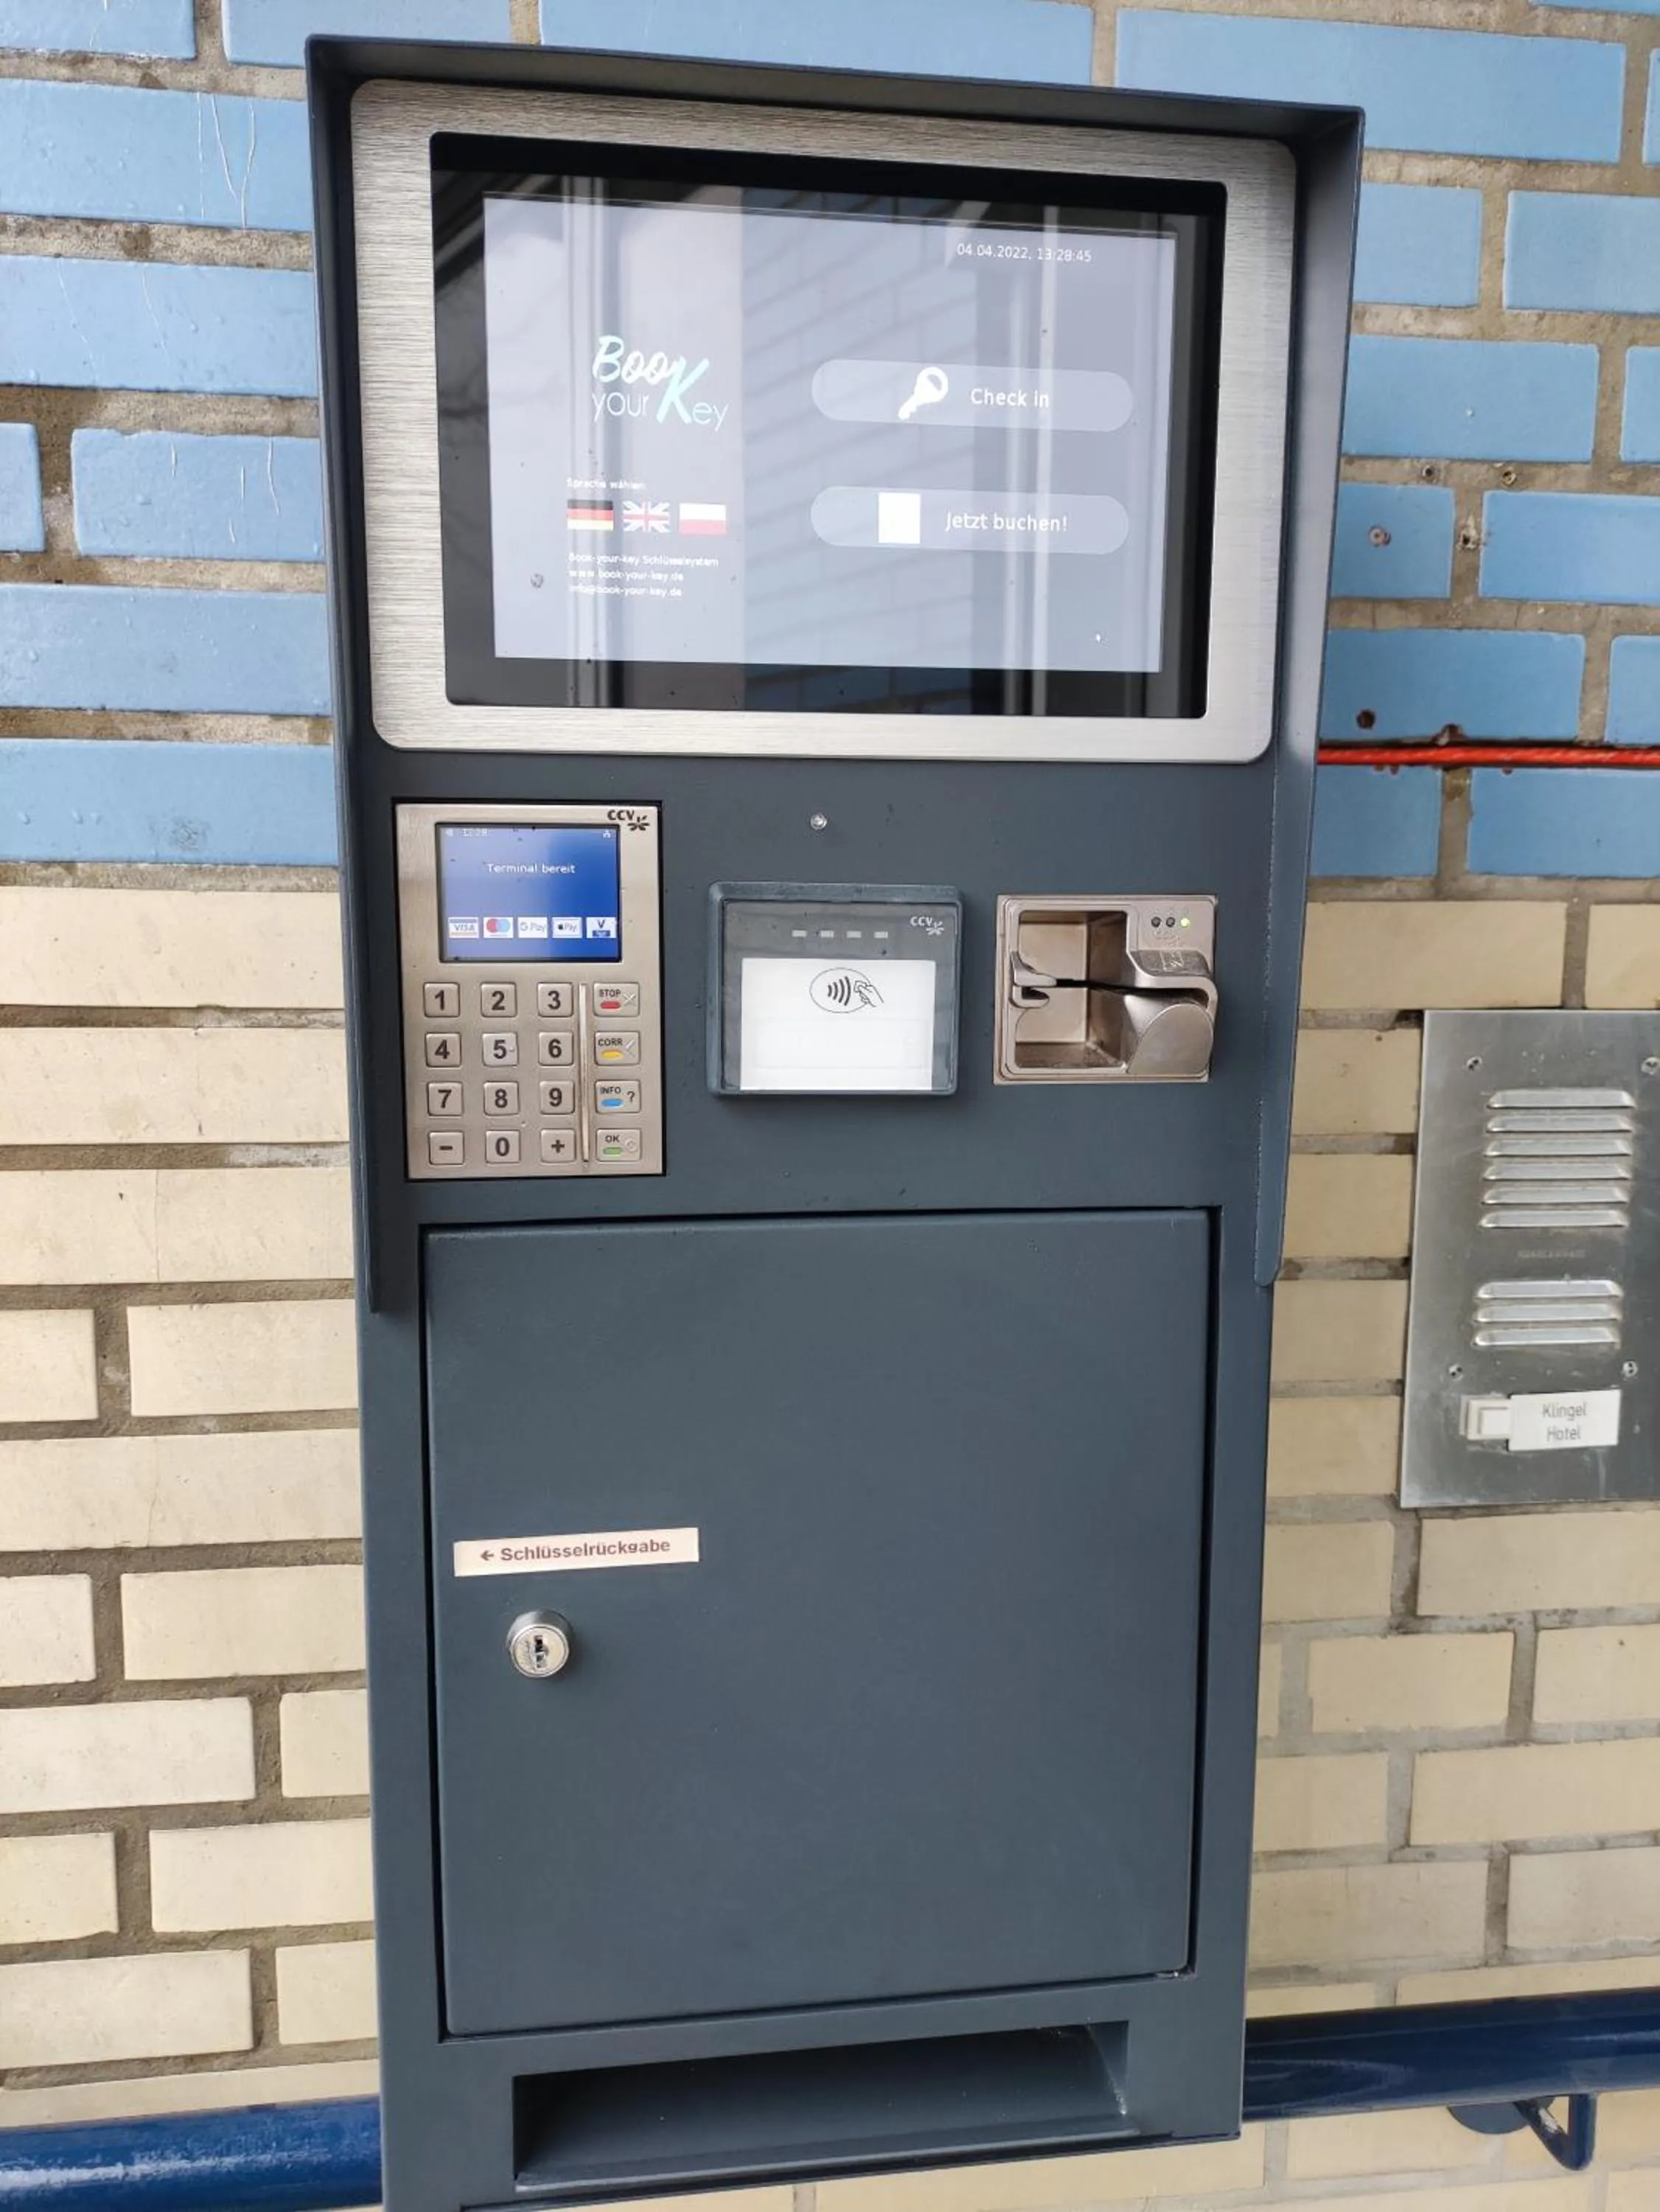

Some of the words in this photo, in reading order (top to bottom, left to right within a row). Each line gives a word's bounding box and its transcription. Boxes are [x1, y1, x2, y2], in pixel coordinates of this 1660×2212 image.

[958, 243, 1031, 260] 04.04.2022,
[1037, 247, 1092, 262] 13:28:45
[592, 392, 649, 423] your
[656, 356, 729, 432] Key
[970, 388, 1027, 408] Check
[1034, 389, 1050, 408] in
[944, 512, 988, 532] Jetzt
[993, 512, 1067, 532] buchen!
[607, 809, 635, 821] CCV
[487, 862, 538, 874] Terminal
[542, 862, 576, 874] bereit
[454, 923, 475, 931] VISA
[910, 916, 932, 926] CCV
[434, 990, 445, 1011] 1
[492, 990, 506, 1011] 2
[548, 990, 561, 1011] 3
[599, 989, 621, 998] STOP
[434, 1040, 450, 1060] 4
[493, 1039, 507, 1060] 5
[548, 1039, 562, 1059] 6
[598, 1038, 623, 1046] CORR
[438, 1089, 452, 1108] 7
[494, 1088, 508, 1108] 8
[548, 1088, 562, 1107] 9
[600, 1087, 621, 1095] INFO
[495, 1137, 510, 1157] 0
[604, 1134, 620, 1144] OK
[1542, 1402, 1587, 1421] Klingel
[1546, 1426, 1581, 1441] Hotel
[500, 1538, 671, 1562] Schlüsselrückgabe
